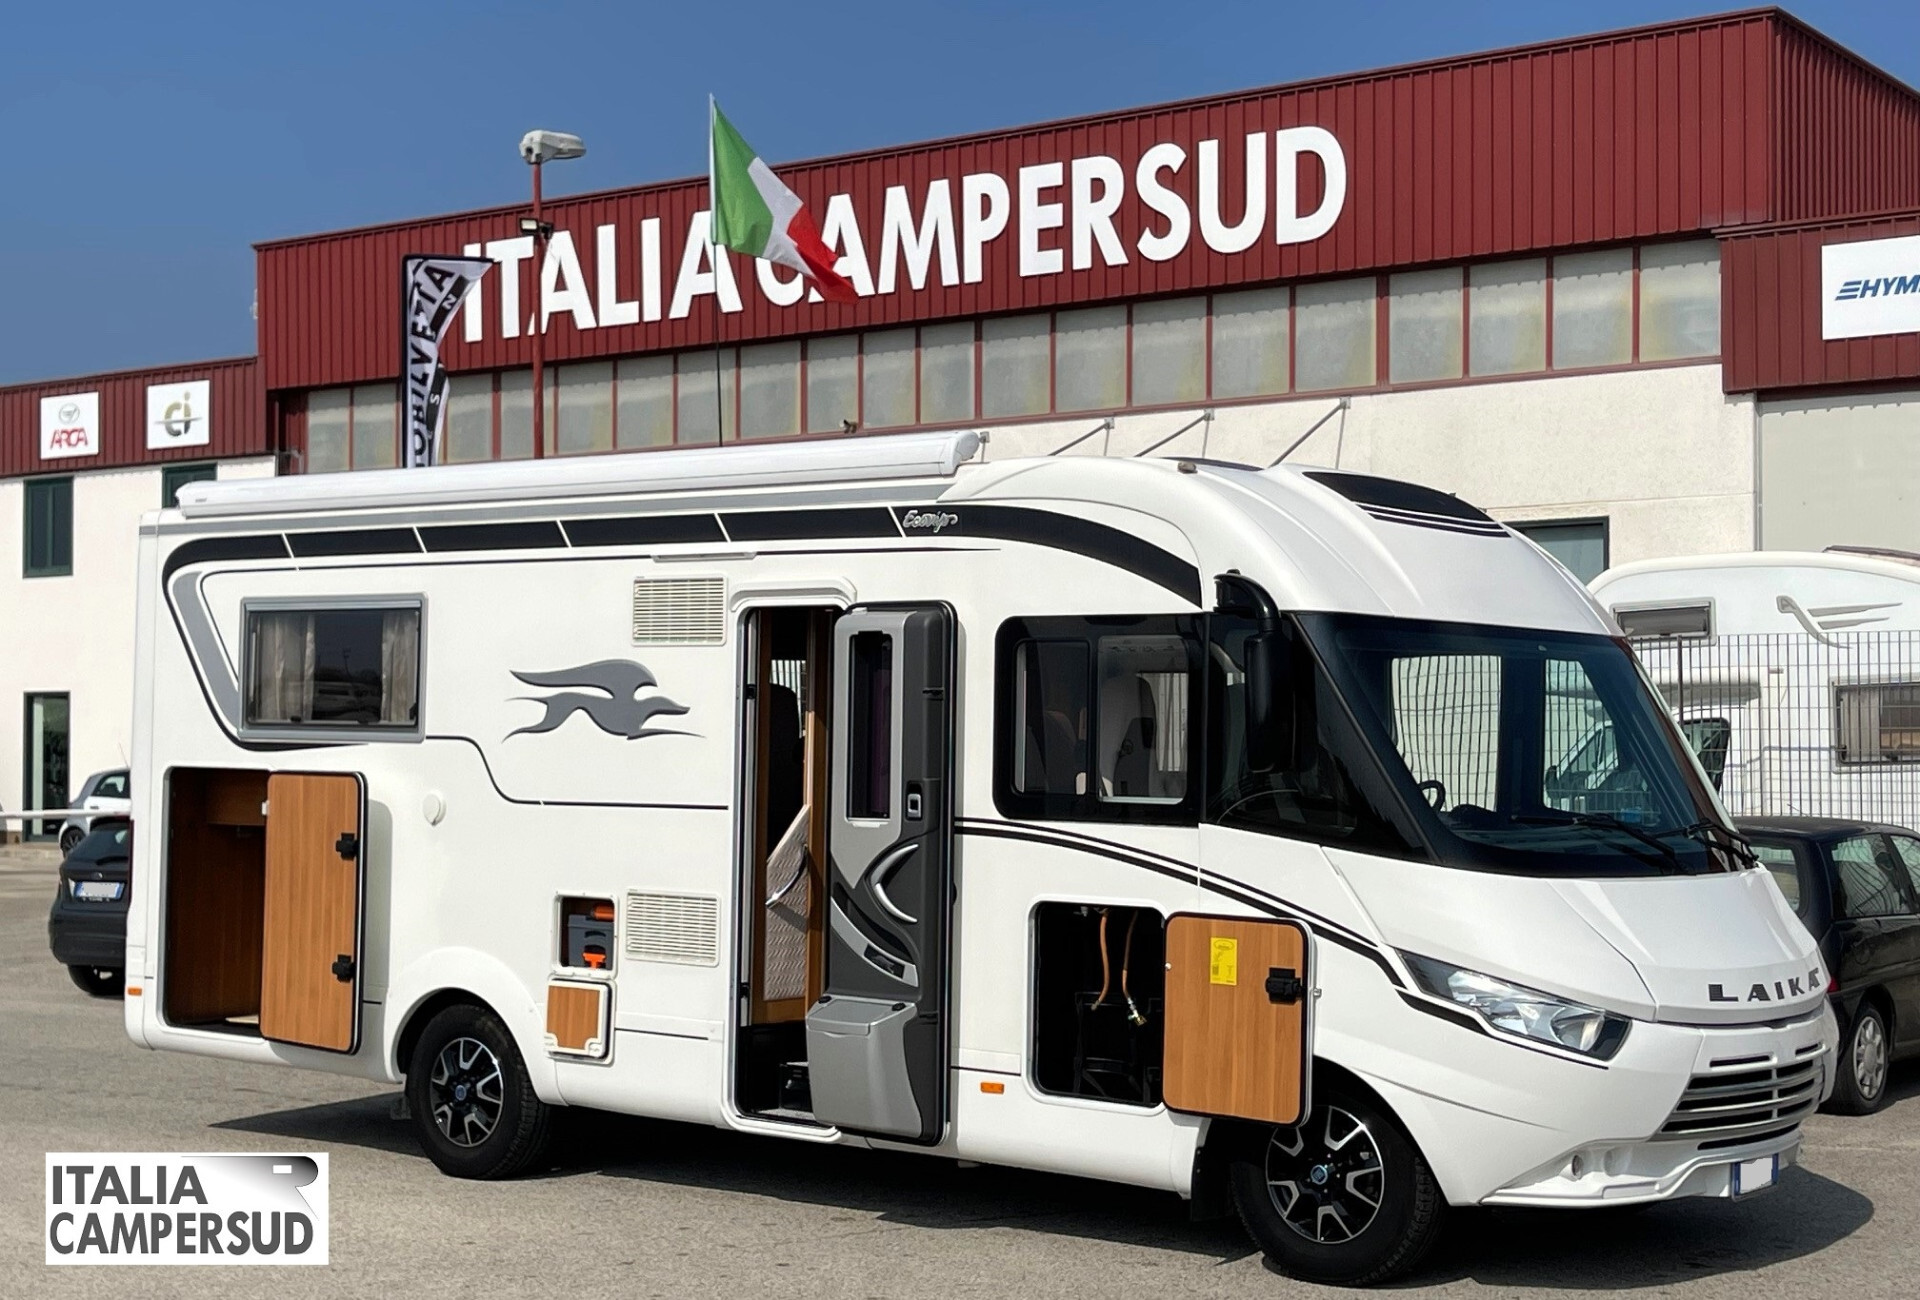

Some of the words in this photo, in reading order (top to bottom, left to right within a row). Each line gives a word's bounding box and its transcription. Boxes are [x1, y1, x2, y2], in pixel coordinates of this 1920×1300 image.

[464, 211, 744, 343] ITALIA
[1858, 274, 1920, 299] HYM
[50, 428, 88, 449] ARCA
[1708, 967, 1821, 1002] LAIKA
